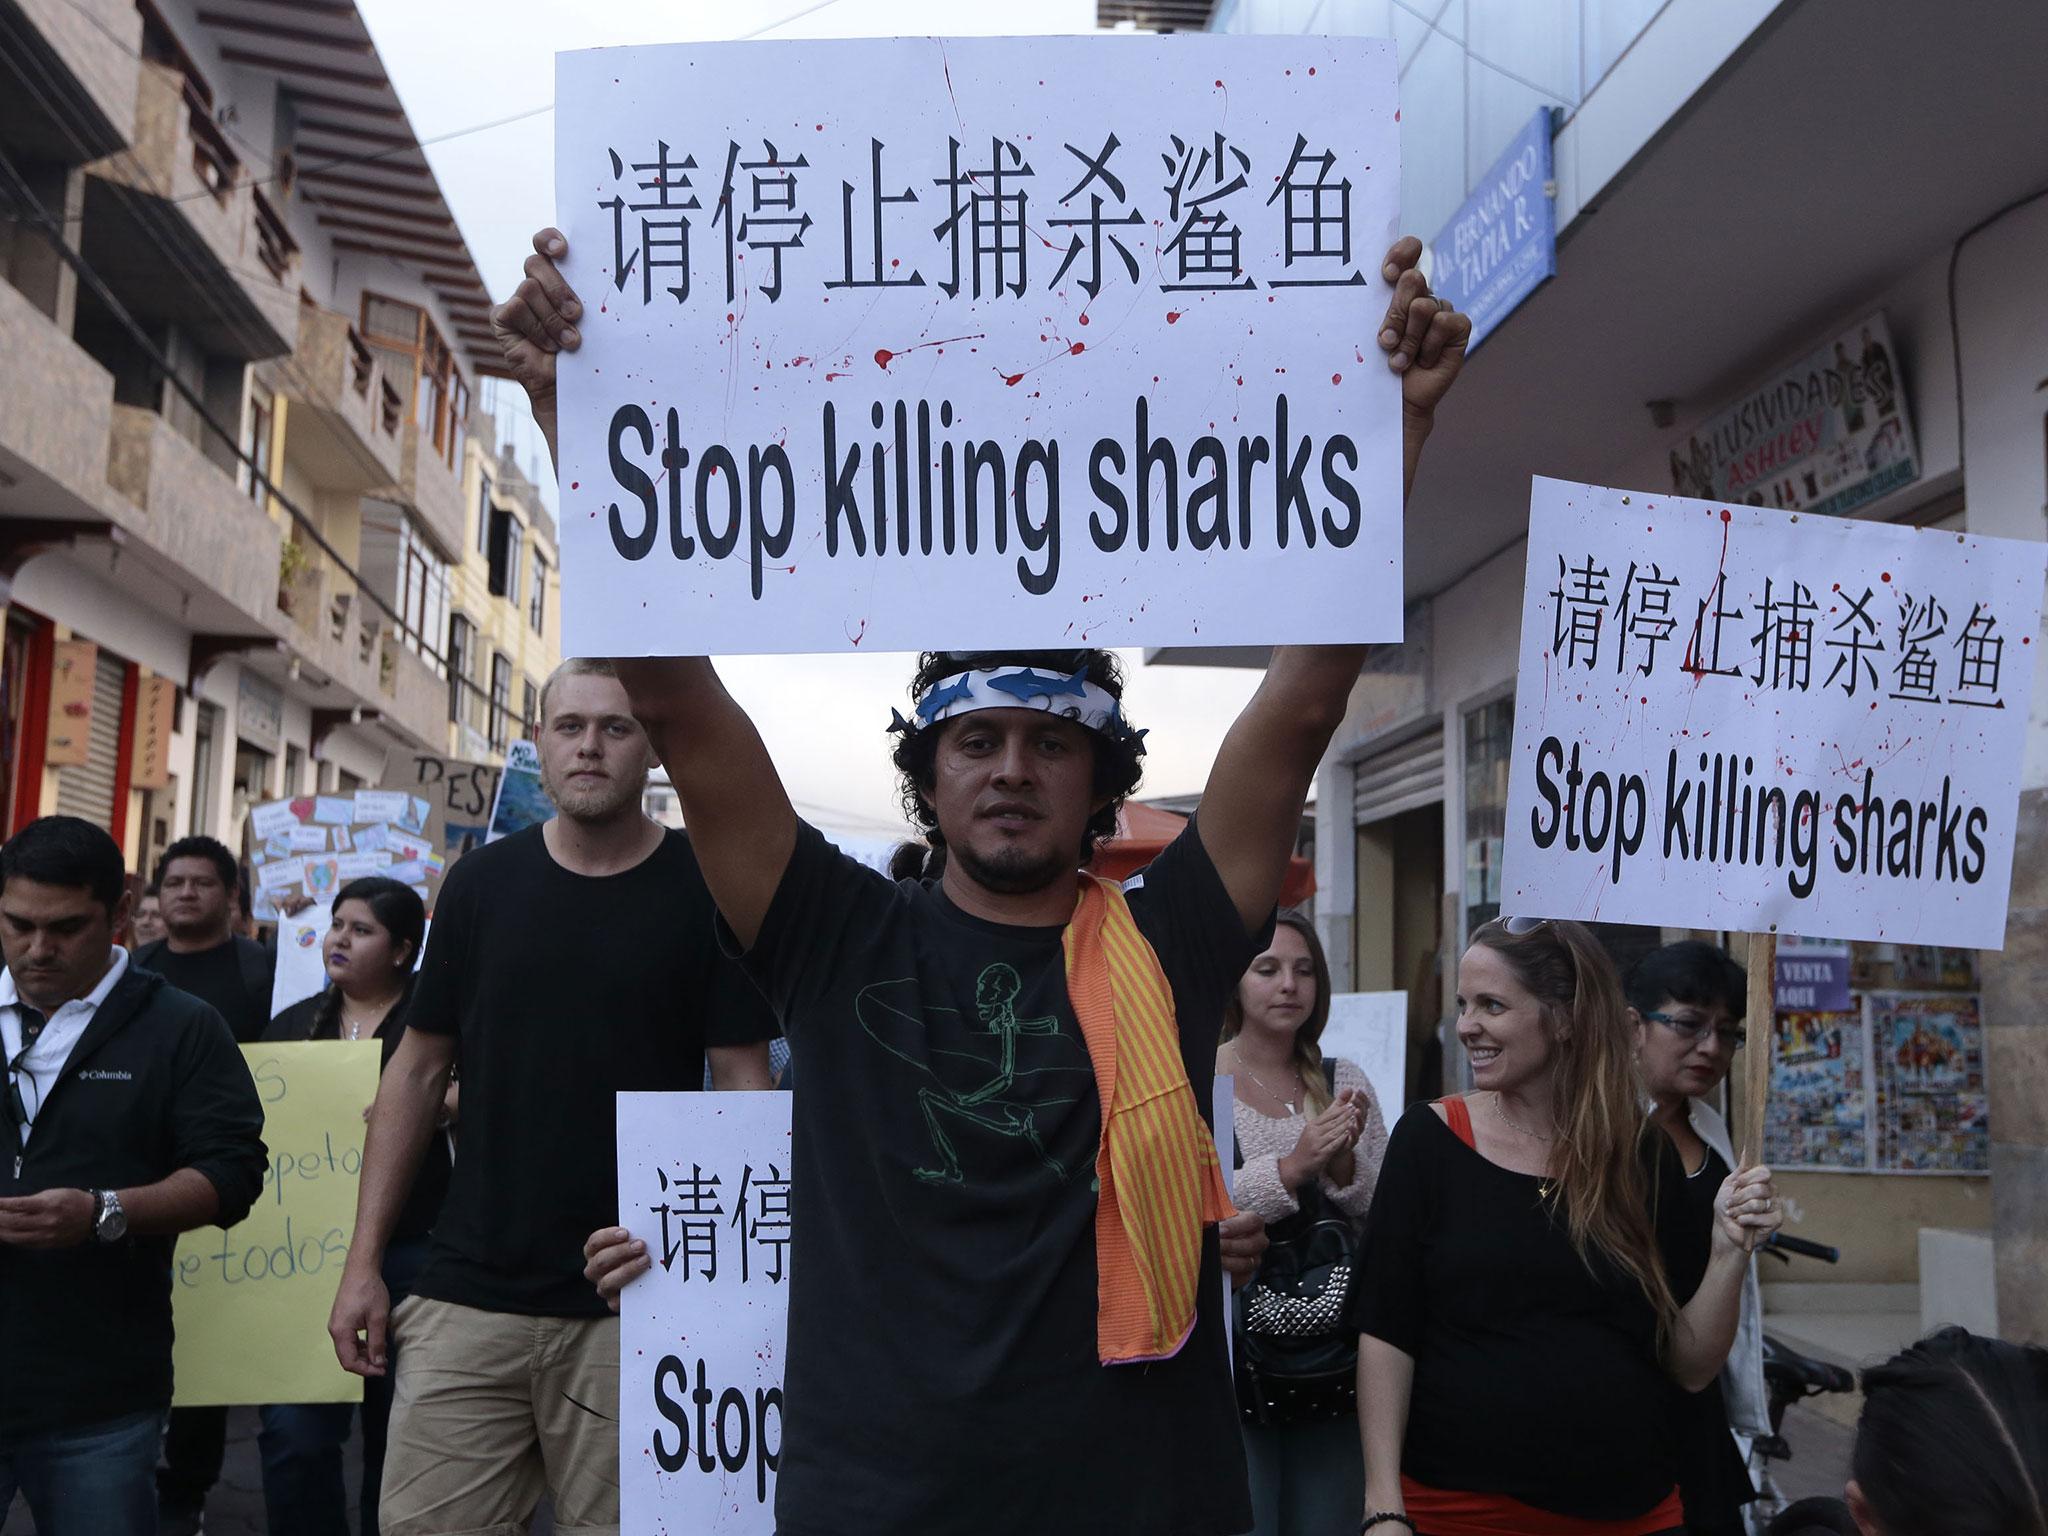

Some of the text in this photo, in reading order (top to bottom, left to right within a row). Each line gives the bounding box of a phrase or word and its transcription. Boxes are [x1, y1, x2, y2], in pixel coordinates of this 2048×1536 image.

[599, 132, 1367, 304] 请停止捕杀鲨鱼
[608, 393, 1361, 600] Stop killing sharks
[1550, 554, 2005, 709] 请停止捕杀鲨鱼
[1531, 736, 1988, 899] Stop killing sharks
[1782, 961, 1833, 983] VENTA
[89, 1070, 132, 1080] Columbia
[653, 1355, 784, 1504] Stop
